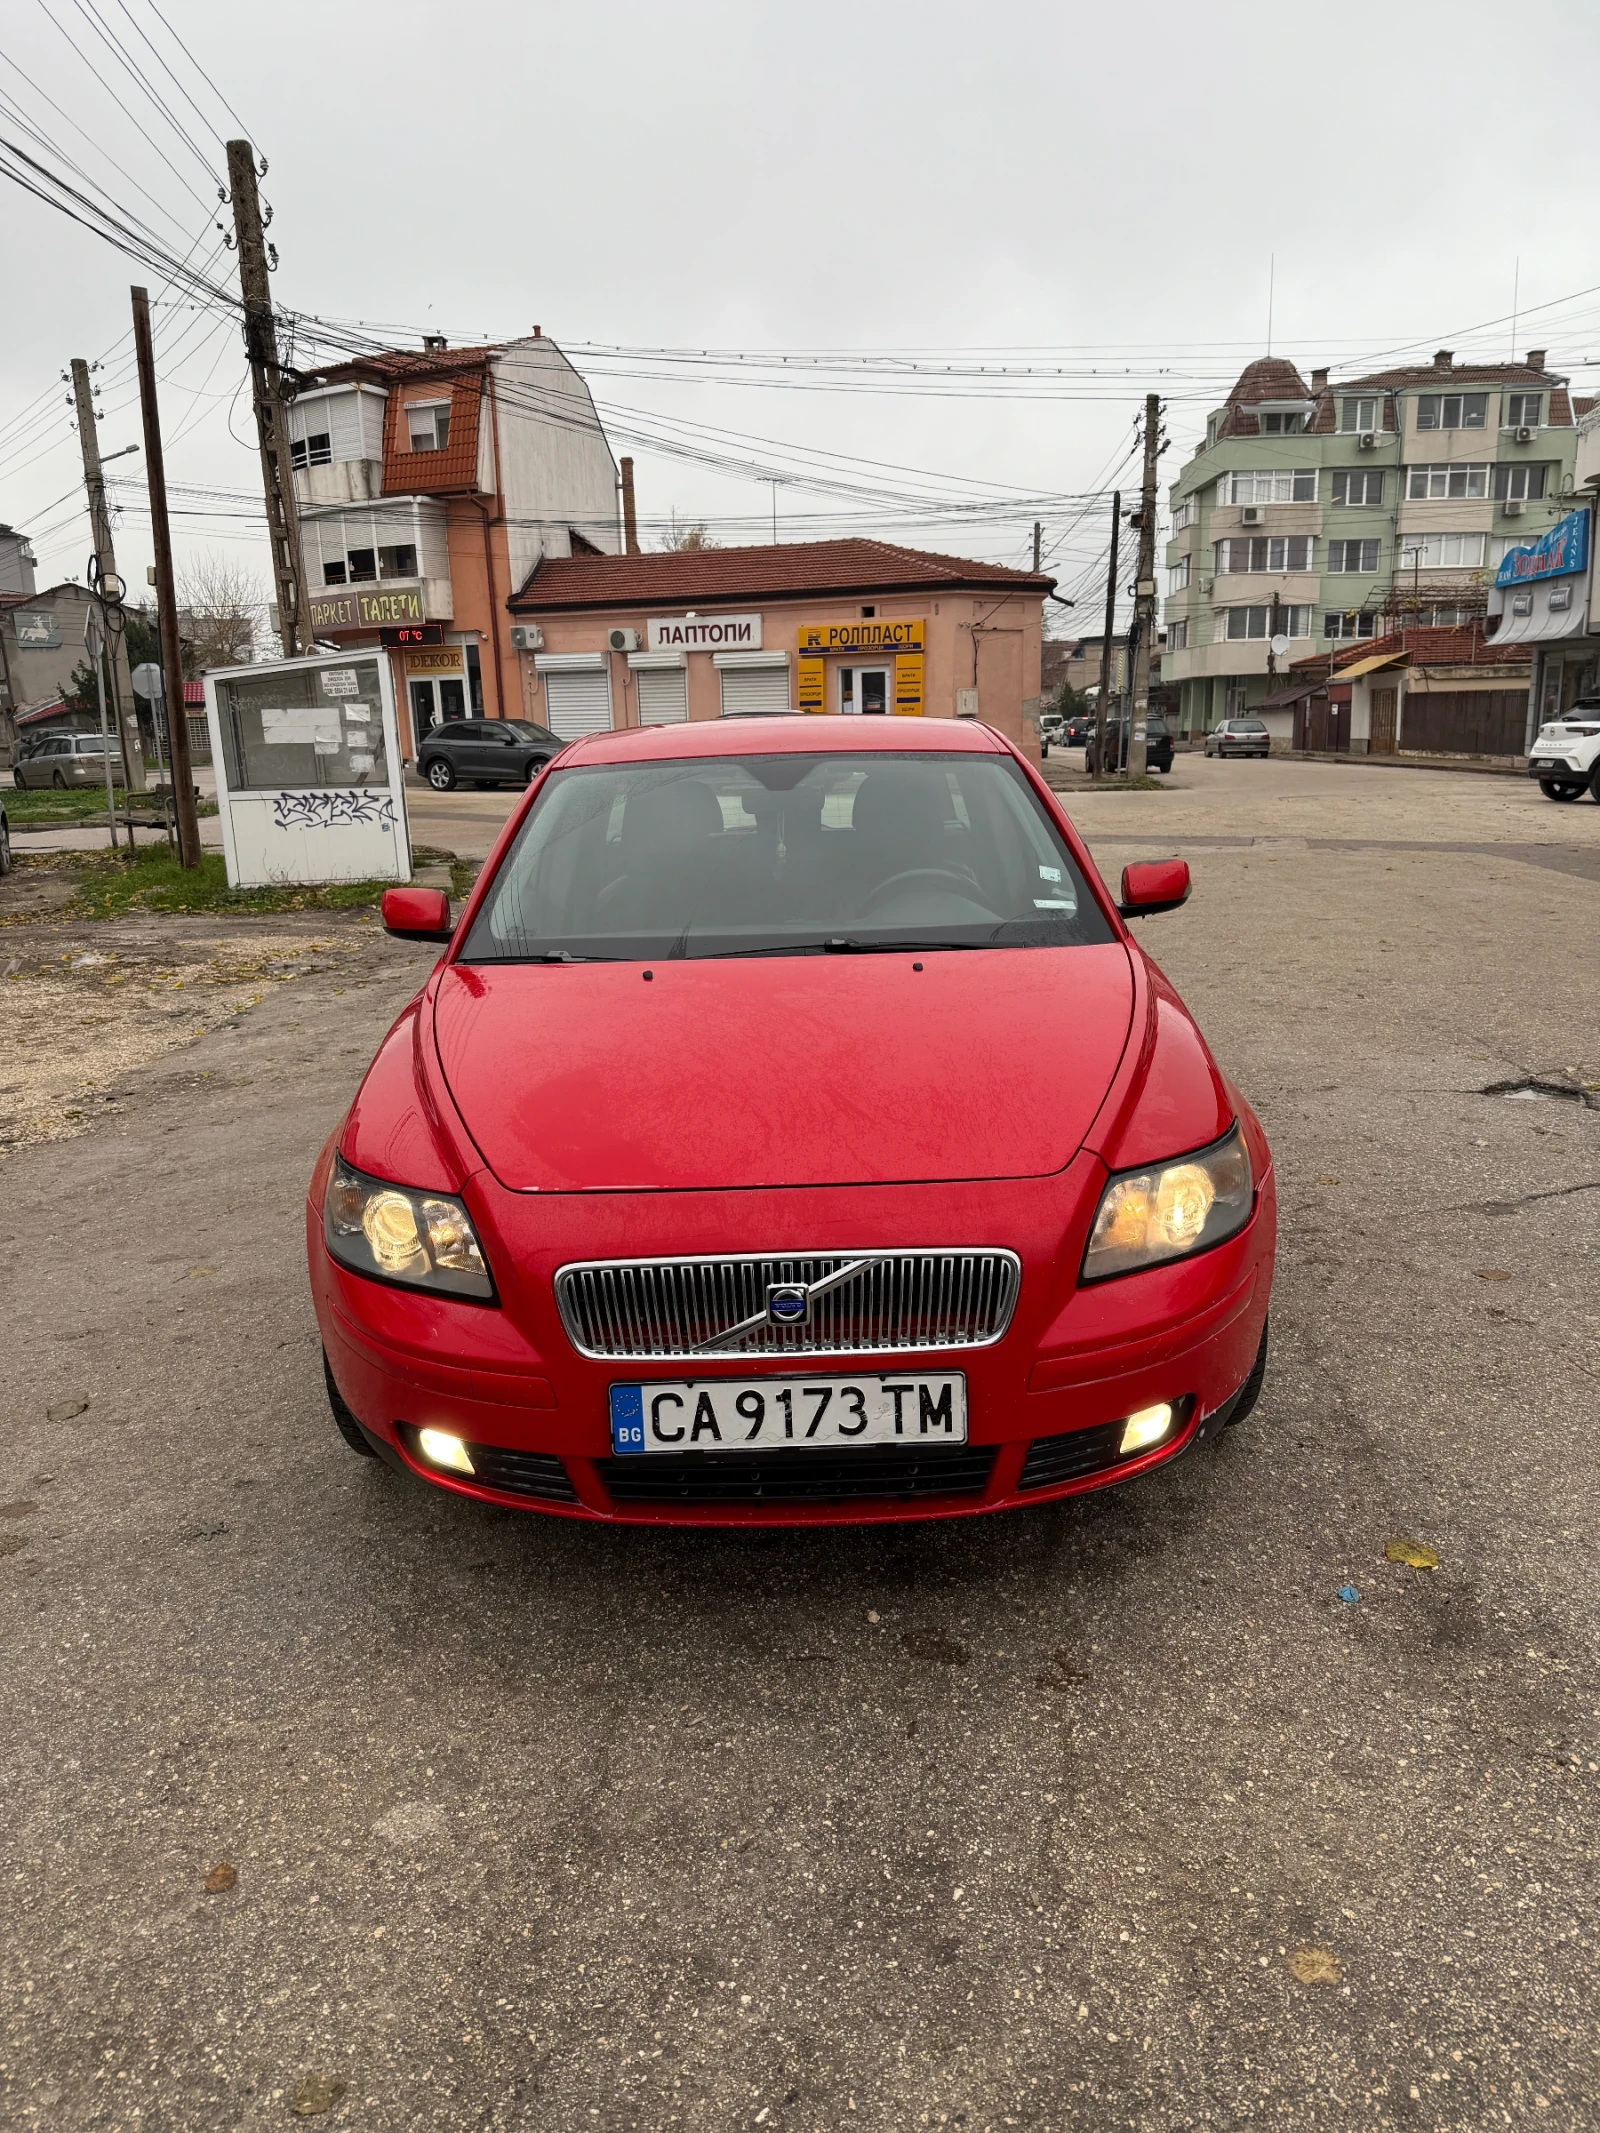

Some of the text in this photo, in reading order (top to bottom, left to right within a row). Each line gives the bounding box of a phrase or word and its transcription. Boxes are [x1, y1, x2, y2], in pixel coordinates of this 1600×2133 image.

[1569, 516, 1578, 568] JEANS
[310, 600, 352, 627] ПАРКЕТ
[360, 594, 420, 622] ТАПЕТИ
[658, 623, 751, 645] ЛАПТОПИ
[829, 624, 913, 645] РОЛПЛАСТ
[410, 653, 461, 668] DEKOR
[651, 1382, 954, 1443] CA 9173 TM
[618, 1427, 642, 1443] BG
